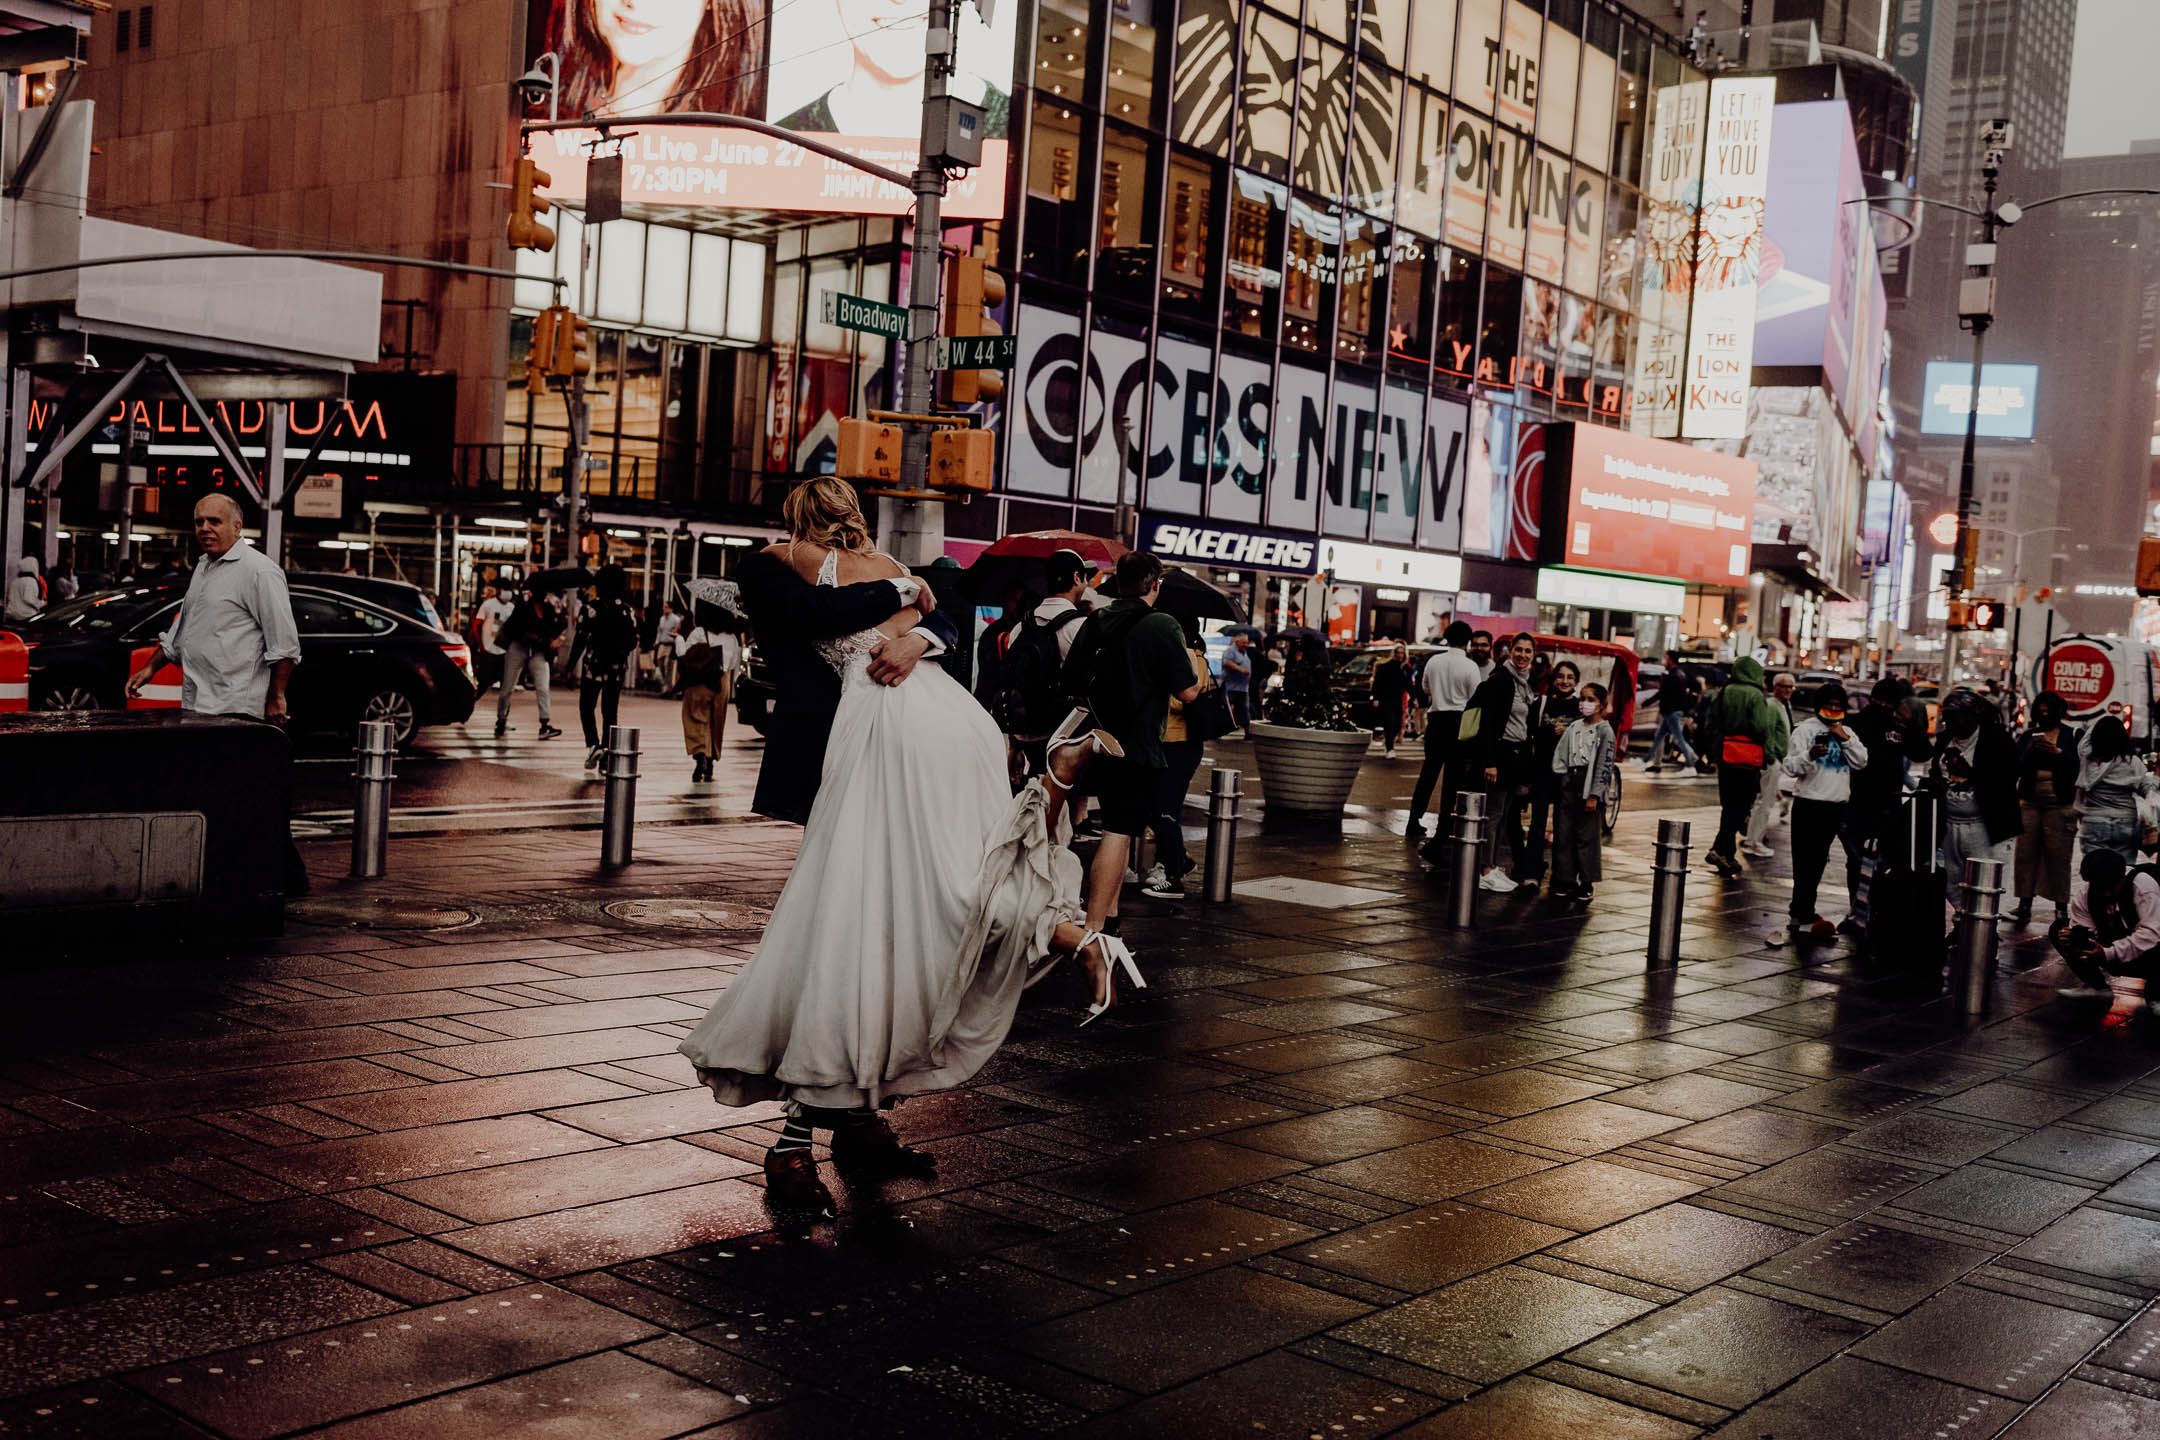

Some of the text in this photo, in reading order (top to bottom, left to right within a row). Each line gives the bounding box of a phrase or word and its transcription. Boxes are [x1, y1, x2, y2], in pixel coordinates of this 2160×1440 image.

[1484, 36, 1537, 108] THE
[1720, 93, 1745, 116] LET
[1718, 119, 1760, 142] MOVE
[643, 135, 698, 162] Live
[703, 138, 769, 166] June
[775, 141, 806, 167] 27
[1415, 73, 1505, 198] LION
[1508, 122, 1593, 236] KING
[1718, 143, 1758, 175] YOU
[630, 164, 728, 194] 7:30PM
[819, 174, 876, 200] JIMMY
[840, 298, 906, 341] Broadway
[952, 340, 1014, 365] W 44 St
[1706, 333, 1736, 346] THE
[1697, 354, 1740, 379] LION
[1690, 384, 1742, 410] KING
[1113, 358, 1463, 524] CBS NEW
[1151, 524, 1314, 569] SKECHERS
[2053, 661, 2104, 679] COVID-19
[2054, 677, 2100, 693] TESTING
